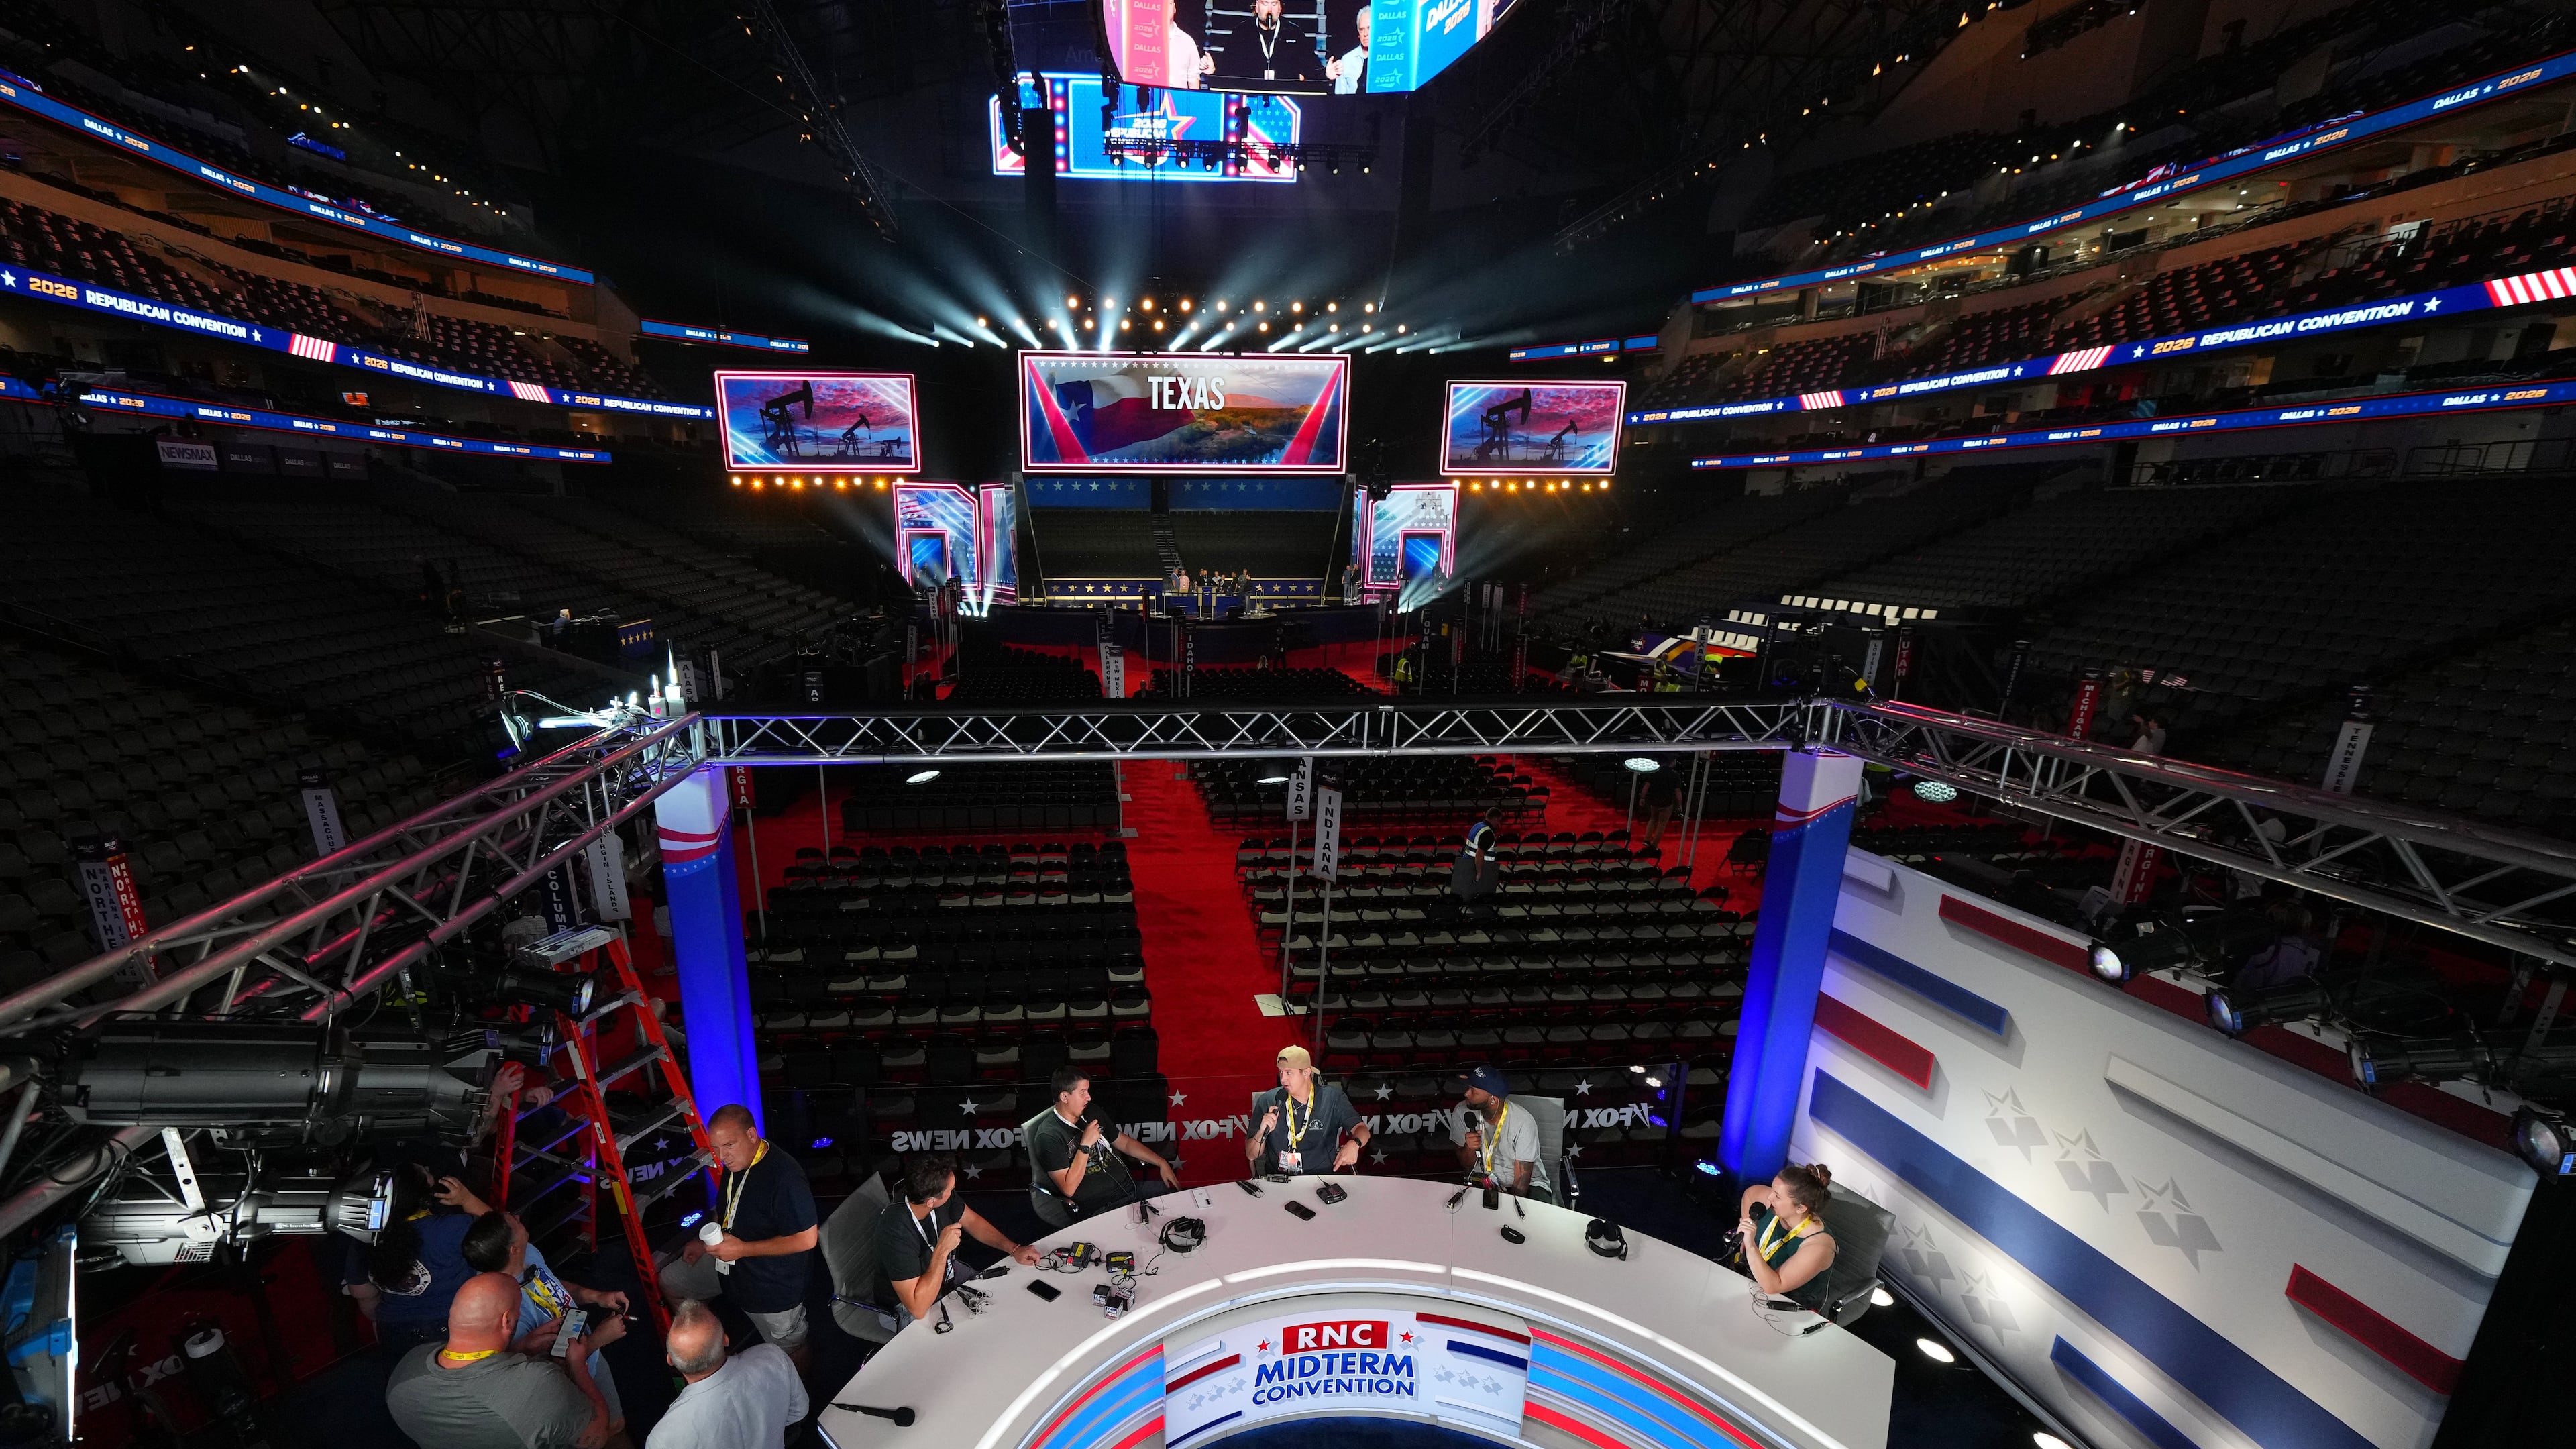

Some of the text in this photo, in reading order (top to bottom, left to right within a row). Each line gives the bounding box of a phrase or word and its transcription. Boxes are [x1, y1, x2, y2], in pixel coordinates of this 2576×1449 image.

[1134, 1, 1161, 11] DALLAS
[1378, 11, 1407, 21] DALLAS
[1444, 3, 1471, 36] 2026
[1134, 44, 1161, 53] DALLAS
[1376, 53, 1405, 62] DALLAS
[2433, 69, 2542, 109] DALLAS 2026
[84, 119, 149, 150] DALLAS 2026
[2265, 128, 2348, 160] DALLAS 2026
[201, 167, 254, 193] DALLAS 2026
[2133, 174, 2199, 200] DALLAS 2026
[310, 204, 365, 225] DALLAS 2026
[2029, 211, 2082, 232] DALLAS 2026
[411, 235, 462, 252] DALLAS 2026
[1921, 239, 1975, 258] DALLAS 2026
[509, 258, 530, 267] DALLAS
[1825, 263, 1875, 278] DALLAS 2026
[29, 277, 246, 338] 2026 REPUBLICAN CONVENTION
[2152, 301, 2414, 354] 2026 REPUBLICAN CONVENTION
[364, 356, 483, 388] 2026 REPUBLICAN CONVENTION
[1872, 368, 2009, 398] 2026 REPUBLICAN CONVENTION
[119, 398, 144, 407] 2026
[575, 396, 700, 415] 2026 REPUBLICAN CONVENTION
[1148, 376, 1225, 411] TEXAS
[2443, 389, 2547, 405] DALLAS 2026
[199, 408, 222, 417] DALLAS
[1670, 408, 1721, 419] REPUBLICAN
[1722, 402, 1773, 415] CONVENTION
[2280, 407, 2361, 419] DALLAS 2026
[160, 446, 214, 462] NEWSMAX
[1421, 620, 1431, 650] GUAM
[1696, 627, 1707, 661] TEXAS
[1187, 634, 1195, 672] IDAHO
[1897, 641, 1911, 676] UTAH
[2072, 684, 2095, 739] MICHIGAN
[2332, 728, 2362, 792] TENNESSEE
[1320, 796, 1334, 875] INDIANA
[100, 868, 119, 920] MARIANA
[120, 863, 139, 914] MARIANA
[606, 872, 619, 913] ISLANDS
[1297, 1324, 1374, 1350] RNC
[1254, 1352, 1415, 1388] MIDTERM
[1252, 1378, 1415, 1405] CONVENTION
